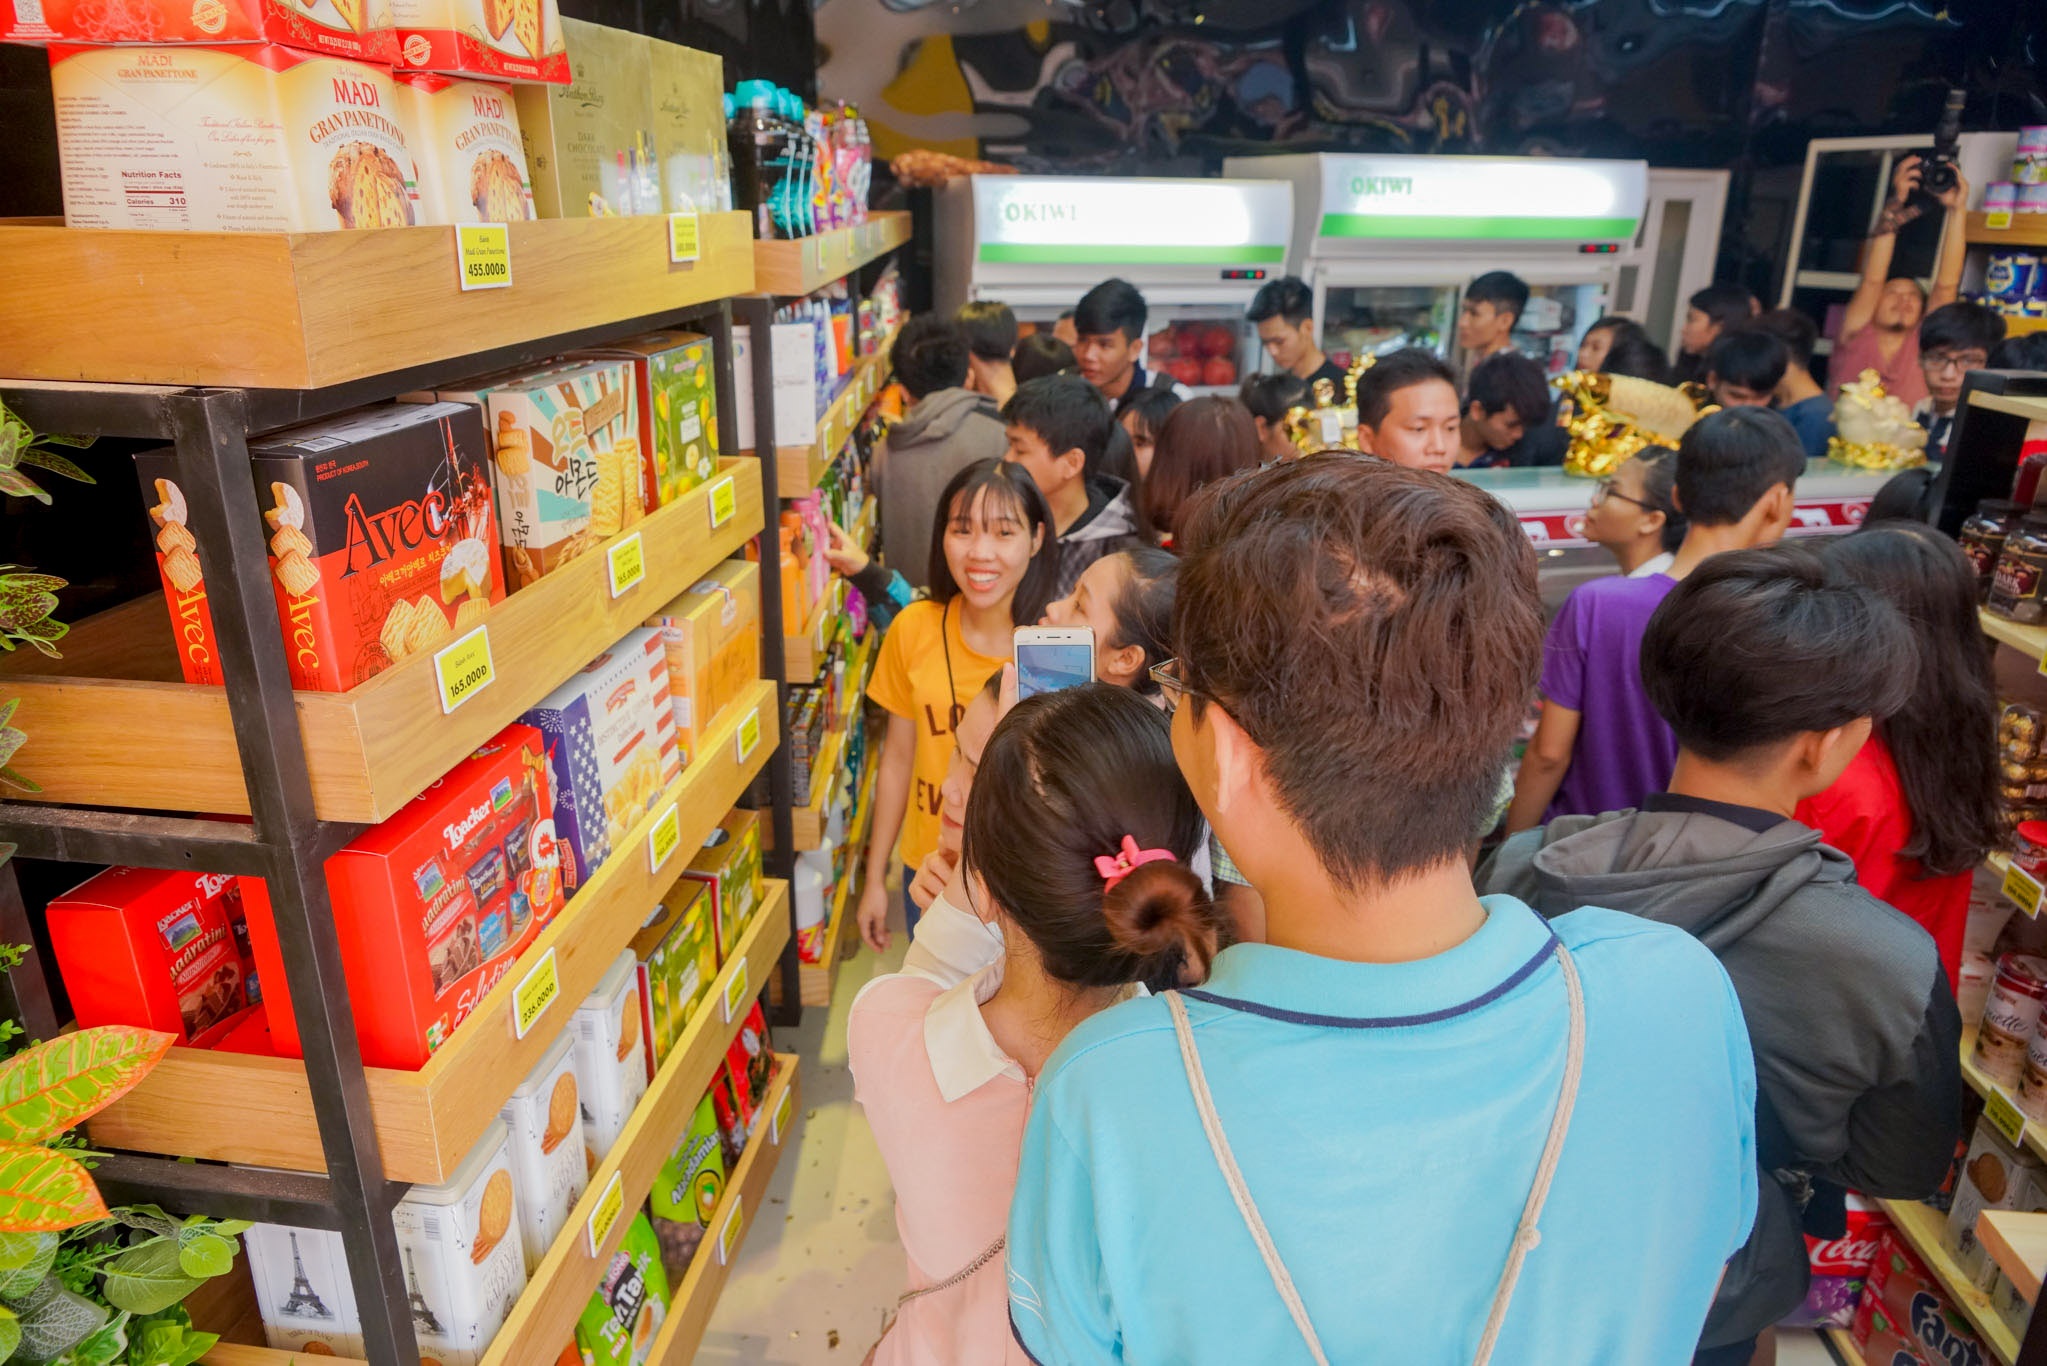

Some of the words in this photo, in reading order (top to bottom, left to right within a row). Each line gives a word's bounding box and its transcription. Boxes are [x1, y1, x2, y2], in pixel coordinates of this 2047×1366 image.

[118, 69, 144, 79] GRAN
[145, 69, 198, 79] PANETTONE
[138, 56, 173, 67] MADI
[332, 77, 380, 107] MADI
[472, 95, 505, 119] MADI
[309, 113, 343, 144] GRAN
[159, 171, 182, 179] Facts
[1351, 177, 1413, 196] OKIWI
[169, 197, 187, 205] 310
[468, 262, 506, 277] 455.000Đ
[555, 456, 600, 501] 아몬드
[340, 490, 450, 580] Avec
[173, 579, 211, 665] Avec
[287, 583, 321, 670] Avec
[450, 664, 488, 698] 165.000Đ
[443, 799, 491, 850] Loacker
[421, 874, 467, 936] uadratini
[169, 922, 227, 982] uadratini
[523, 981, 555, 1024] 236.000Đ
